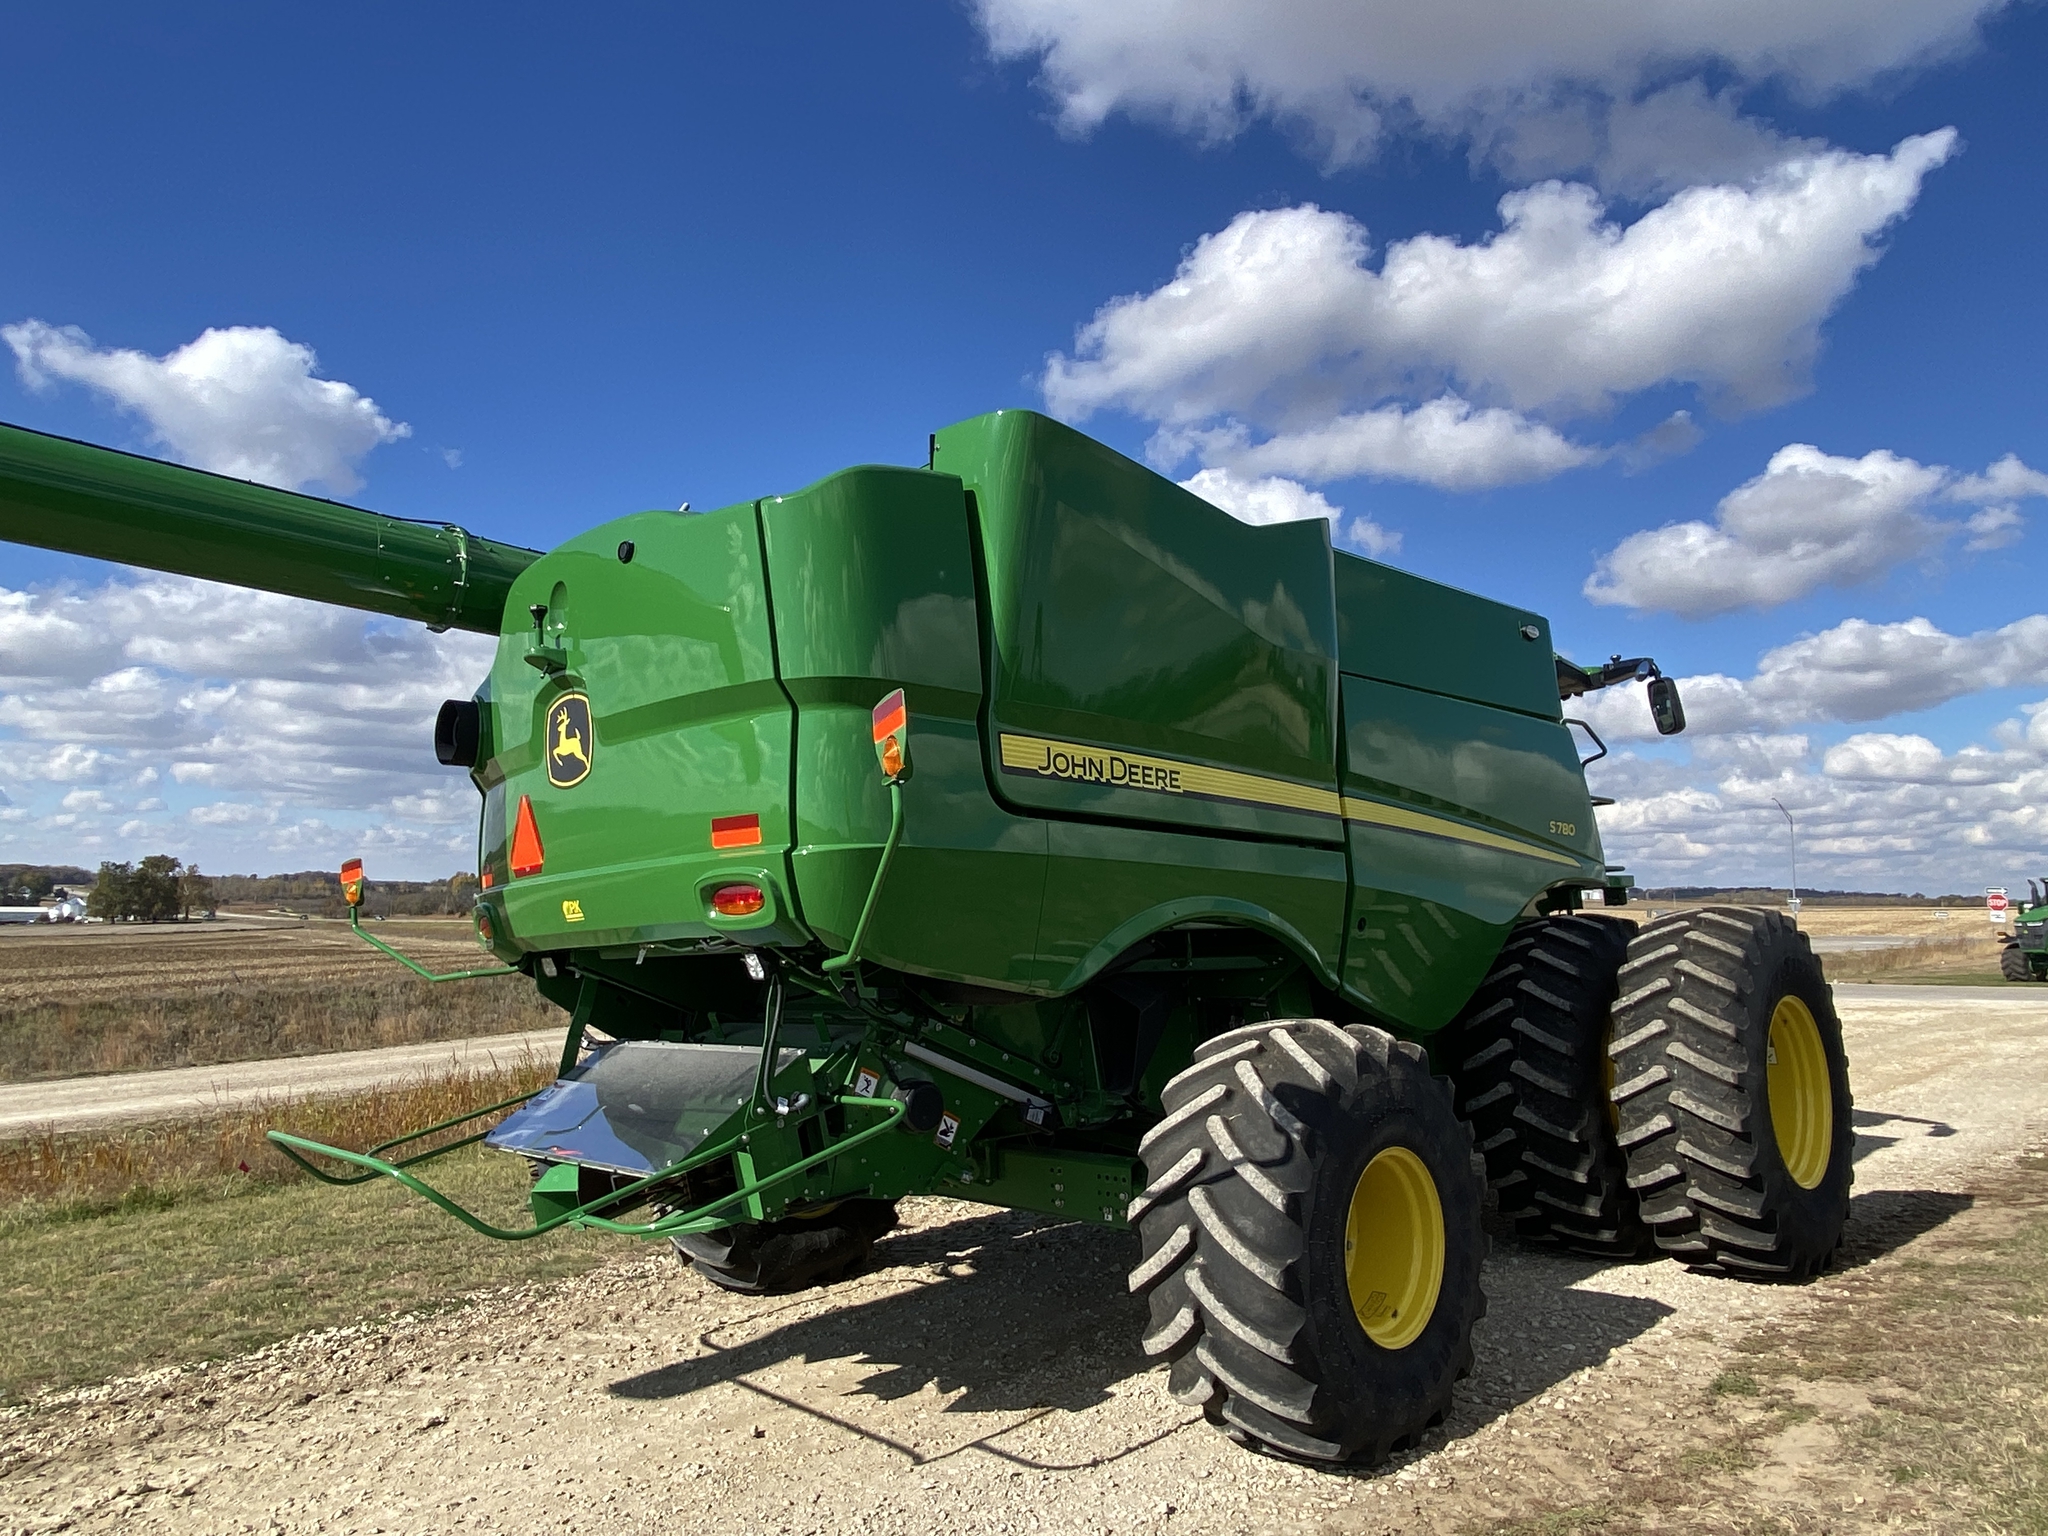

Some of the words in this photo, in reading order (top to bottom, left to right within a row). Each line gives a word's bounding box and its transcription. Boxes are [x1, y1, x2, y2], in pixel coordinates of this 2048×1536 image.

[1037, 746, 1105, 782] JOHN
[1109, 756, 1182, 791] DEERE
[1549, 820, 1576, 836] S780
[1988, 898, 2006, 907] STOP
